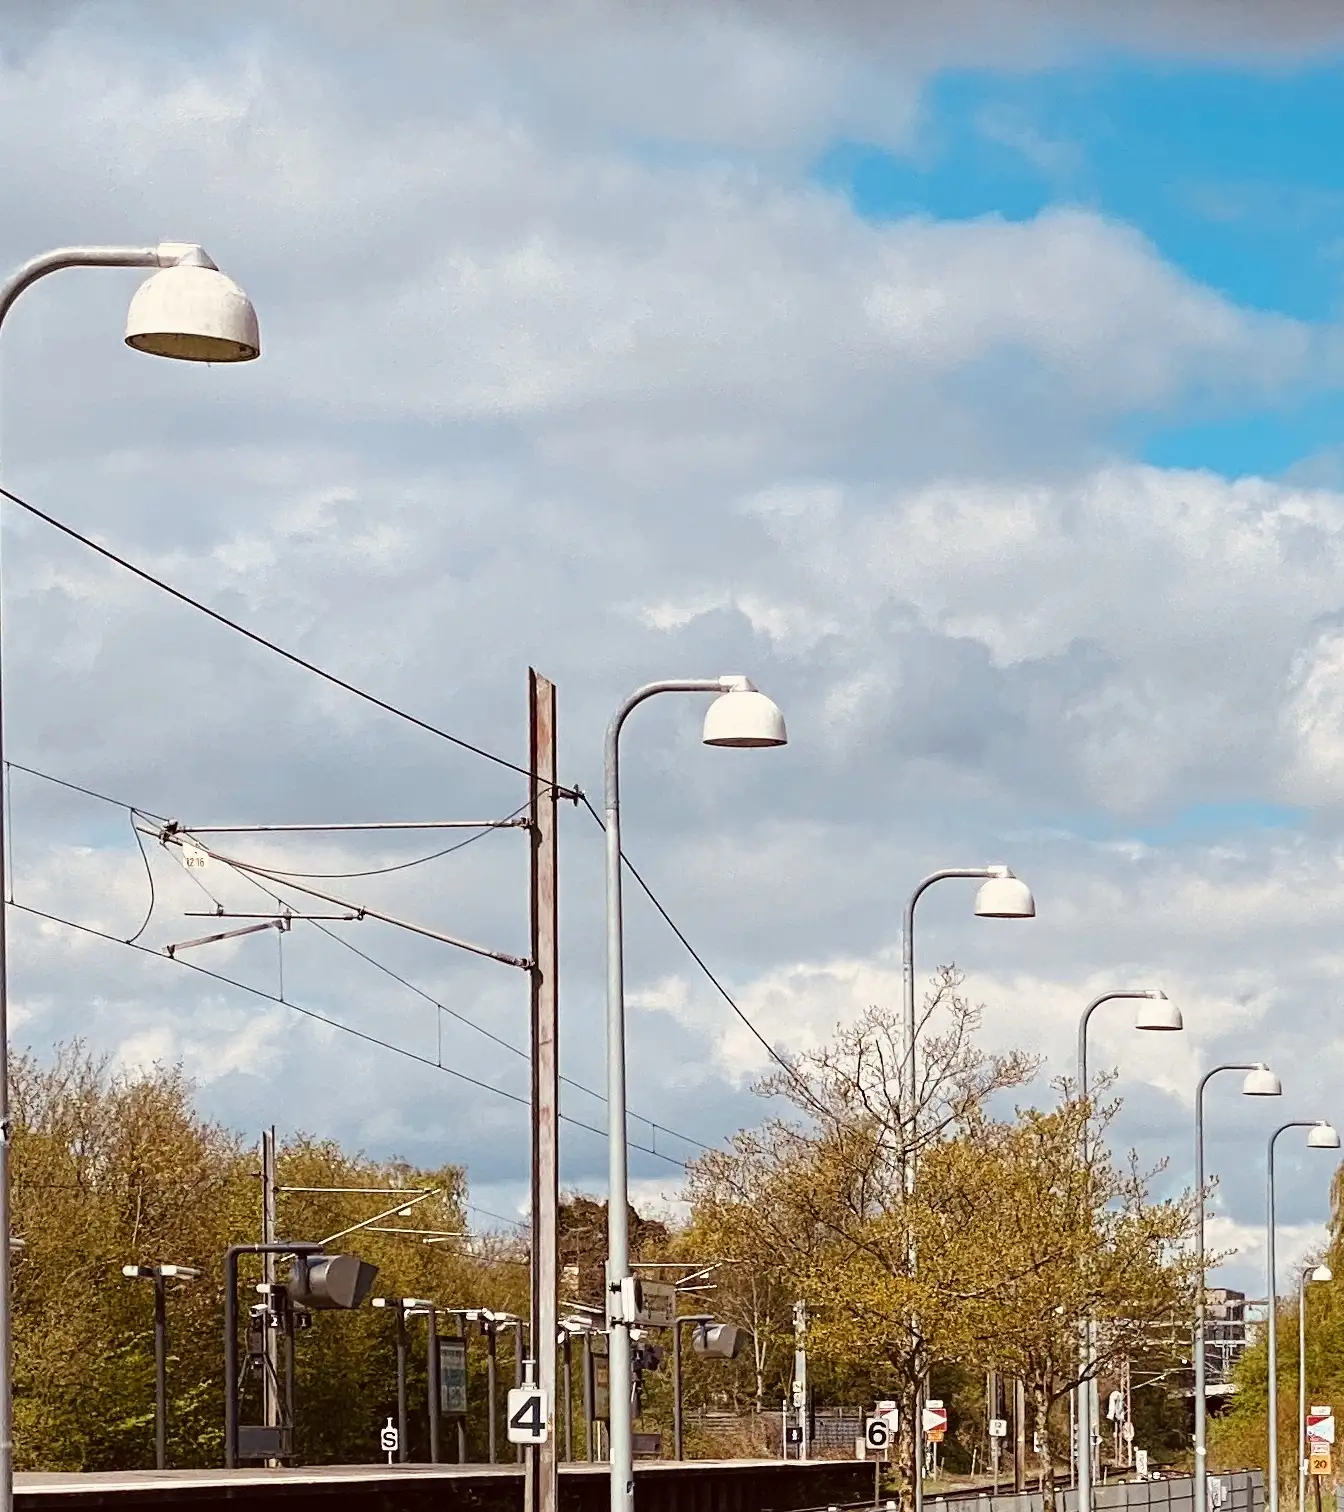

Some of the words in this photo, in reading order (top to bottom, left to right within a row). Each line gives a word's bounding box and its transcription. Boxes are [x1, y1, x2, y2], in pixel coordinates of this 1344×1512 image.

[510, 1396, 546, 1437] 4
[383, 1432, 397, 1448] S
[868, 1421, 887, 1446] 6
[1313, 1460, 1328, 1469] 20
